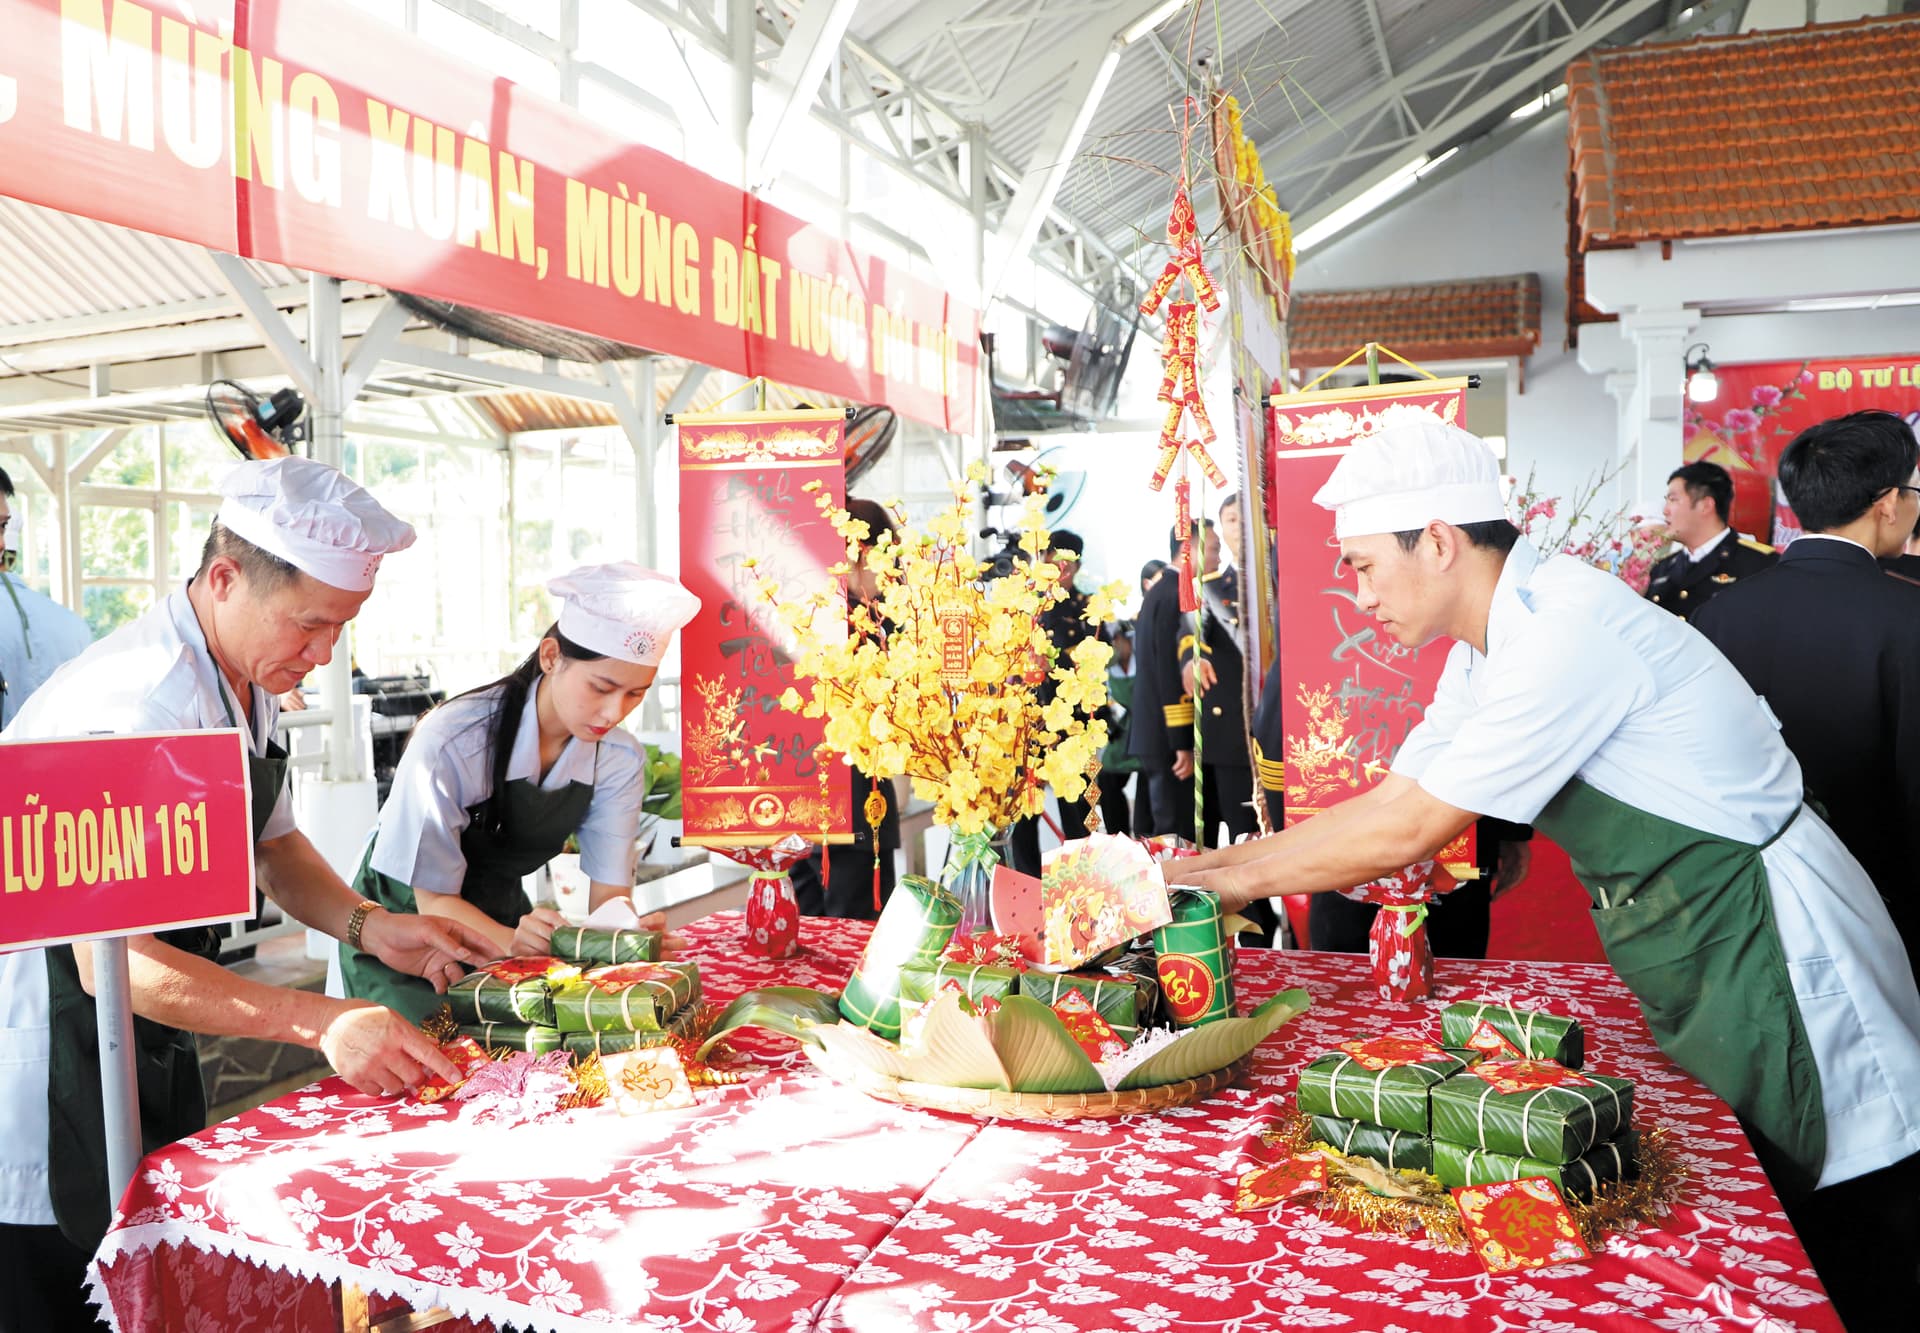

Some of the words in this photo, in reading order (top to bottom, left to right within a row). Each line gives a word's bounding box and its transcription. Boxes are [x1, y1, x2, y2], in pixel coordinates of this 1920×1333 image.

[61, 0, 342, 208] MỪNG
[366, 97, 549, 281] XUÂN,
[566, 177, 701, 316] MỪNG
[712, 223, 782, 340] ĐẤT
[1818, 367, 1853, 392] BỘ
[1859, 365, 1895, 388] TƯ
[3, 793, 48, 893] LỮ
[54, 791, 147, 887] ĐOÀN
[155, 801, 209, 876] 161
